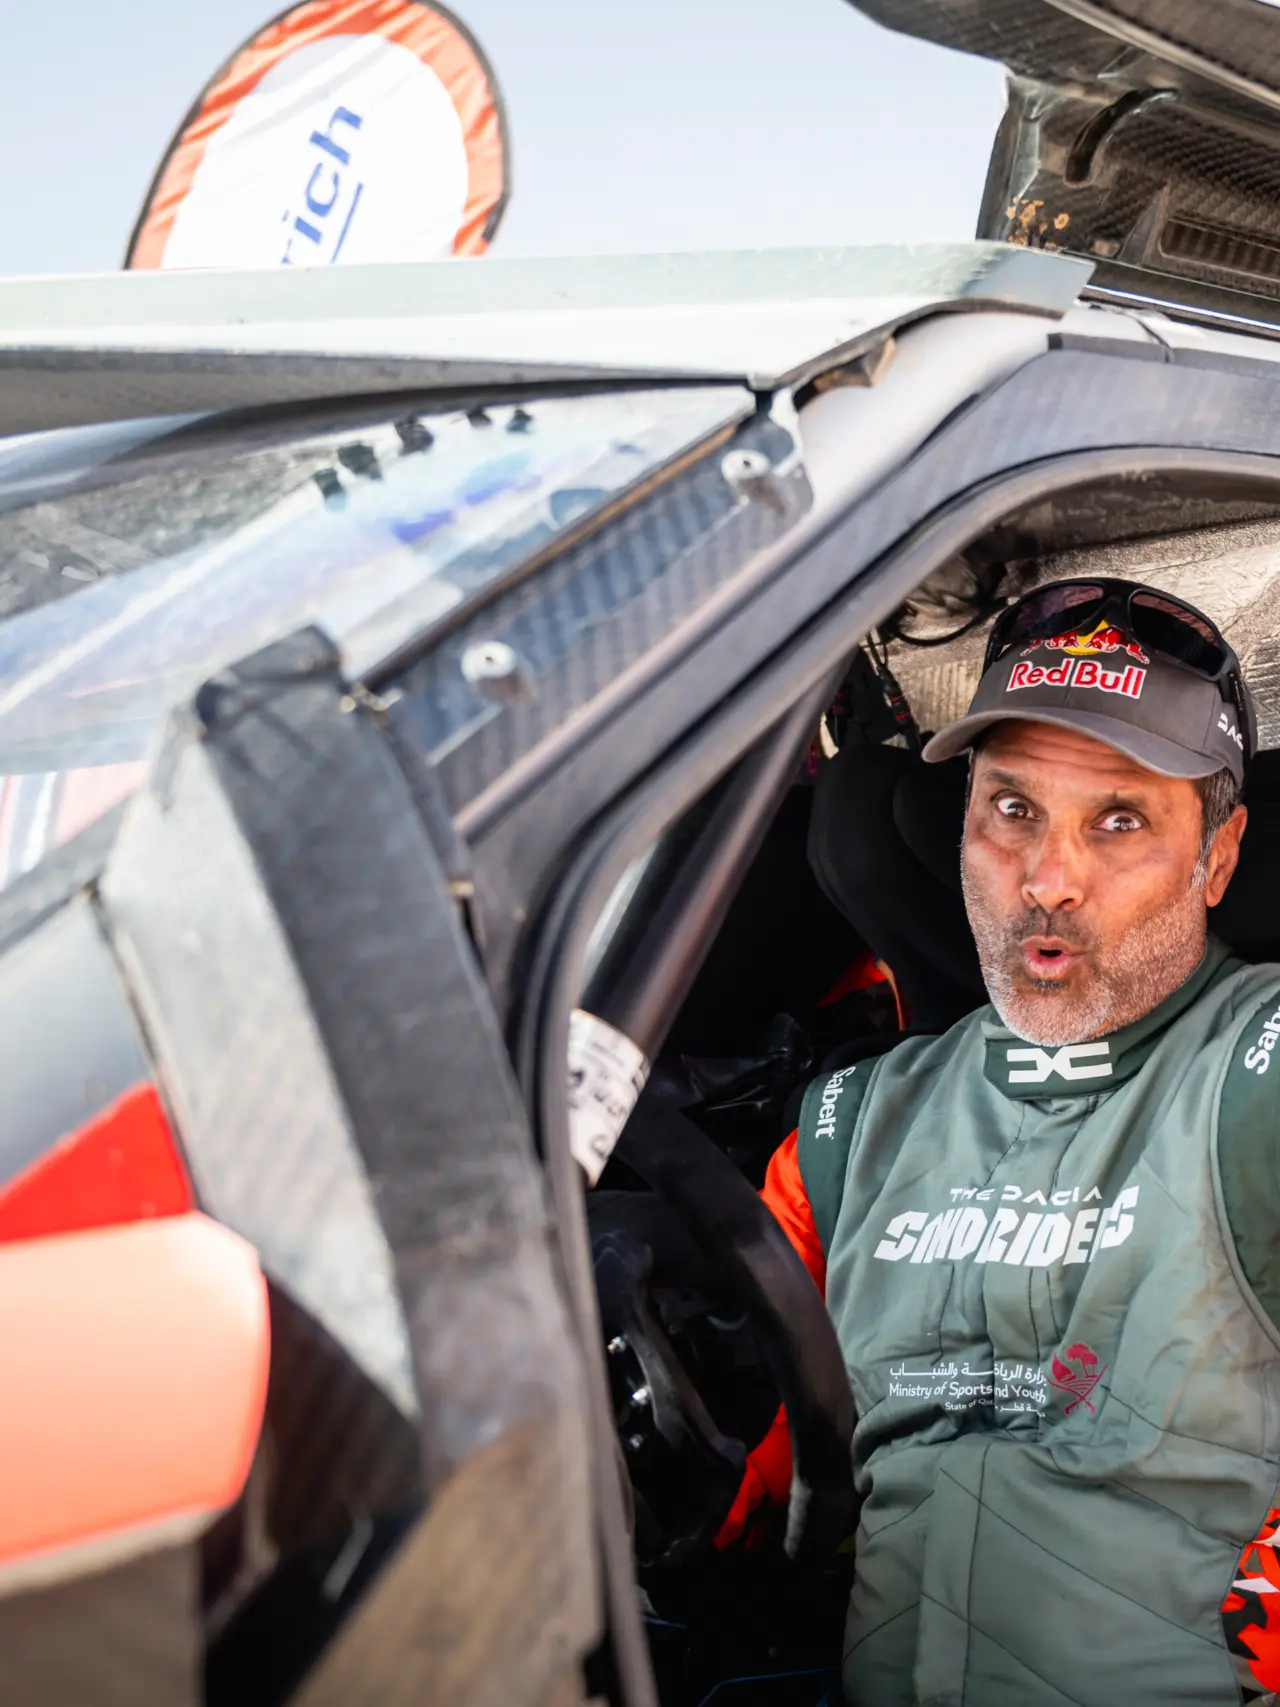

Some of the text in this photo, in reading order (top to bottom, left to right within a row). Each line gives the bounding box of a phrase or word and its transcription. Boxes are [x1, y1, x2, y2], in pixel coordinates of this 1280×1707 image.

[1006, 658, 1148, 700] Red Bull
[815, 1066, 856, 1140] Sabelt
[950, 1187, 996, 1203] THE
[889, 1381, 1046, 1404] Ministry of Sports nd Youth
[945, 1402, 967, 1411] State
